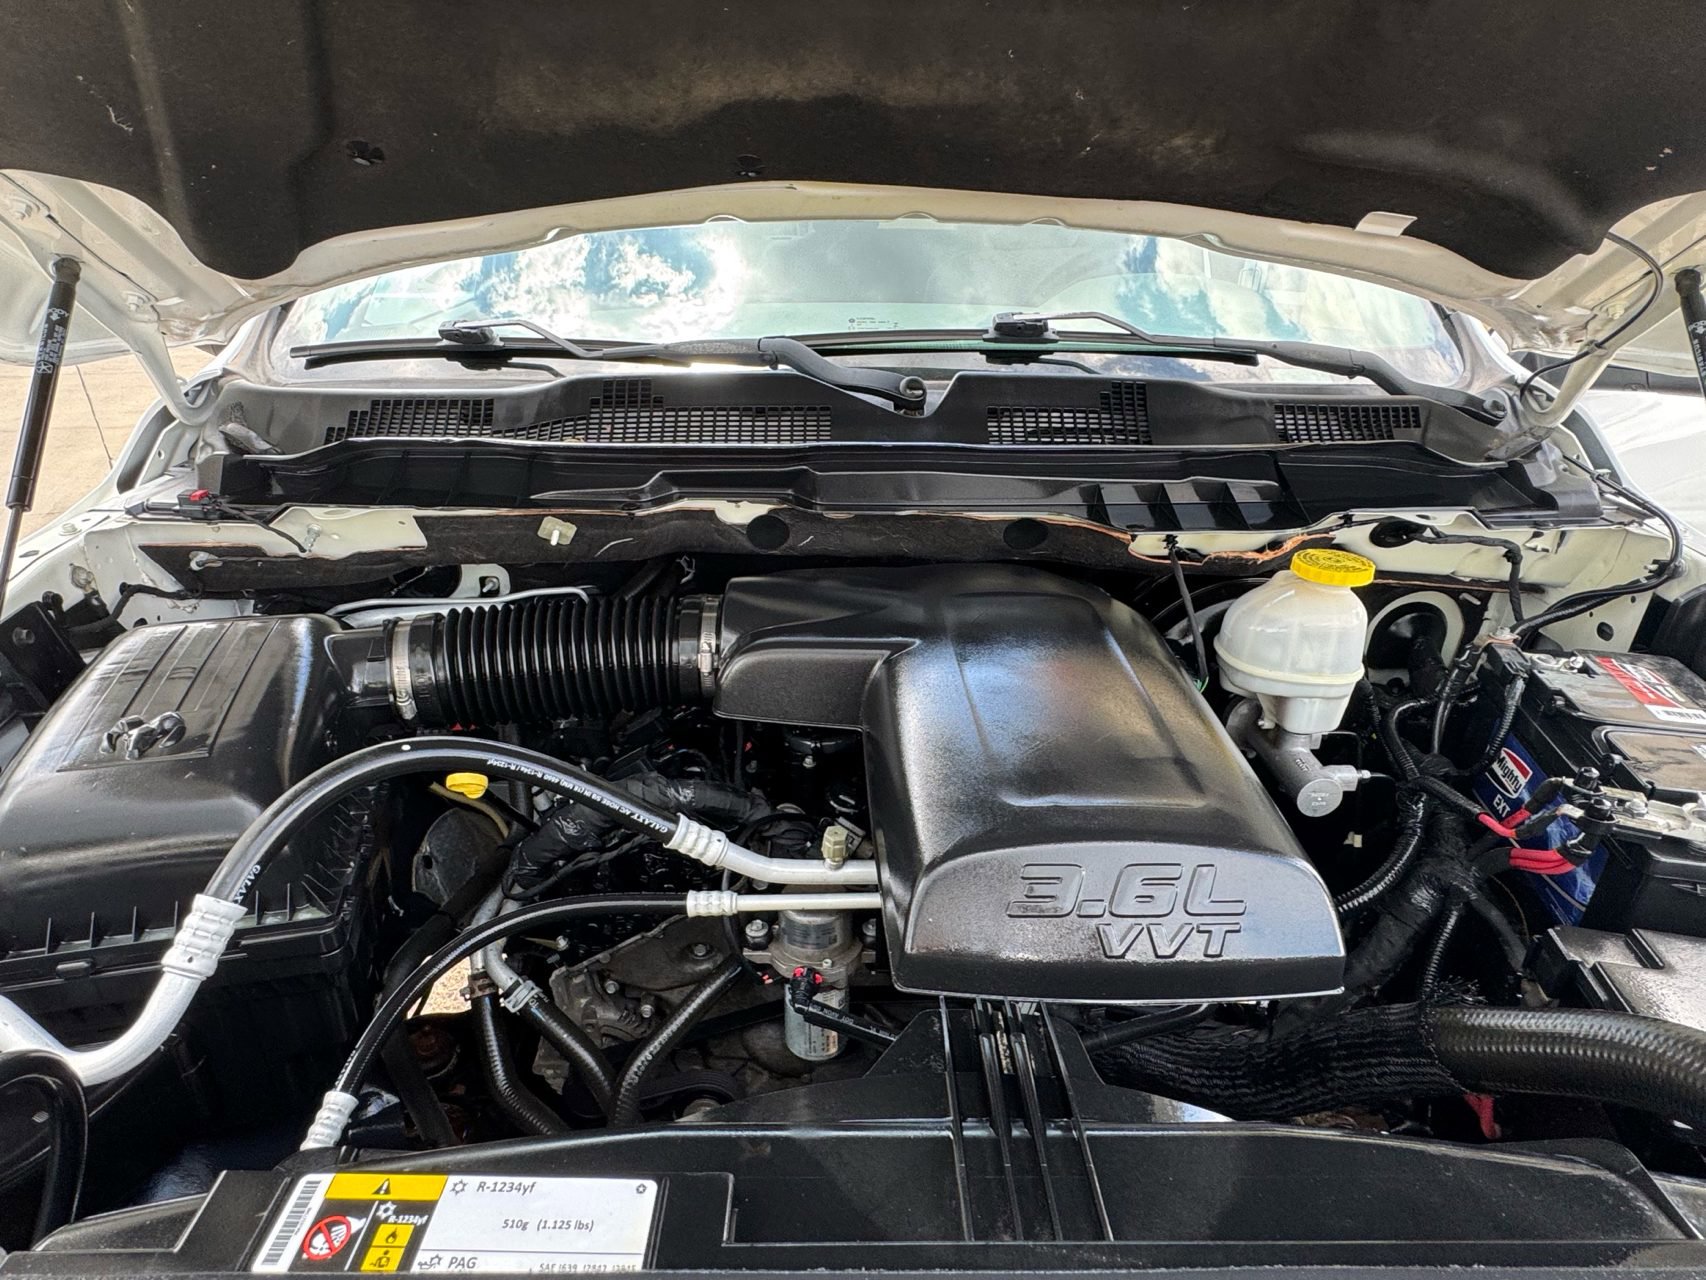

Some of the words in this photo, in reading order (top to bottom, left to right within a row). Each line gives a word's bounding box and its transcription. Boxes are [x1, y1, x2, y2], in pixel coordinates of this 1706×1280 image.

[1496, 755, 1522, 793] Mighty
[1493, 794, 1511, 817] EXT
[632, 813, 668, 833] GALAXY
[233, 864, 261, 905] GALAX
[1006, 863, 1247, 918] 3.6L
[1095, 921, 1242, 959] VVT
[476, 1181, 536, 1196] R-1234yf
[387, 1214, 429, 1226] R-1234yf
[502, 1218, 529, 1231] 510g
[537, 1219, 571, 1231] (1.125
[574, 1219, 594, 1232] lbs)
[448, 1257, 477, 1269] PAG
